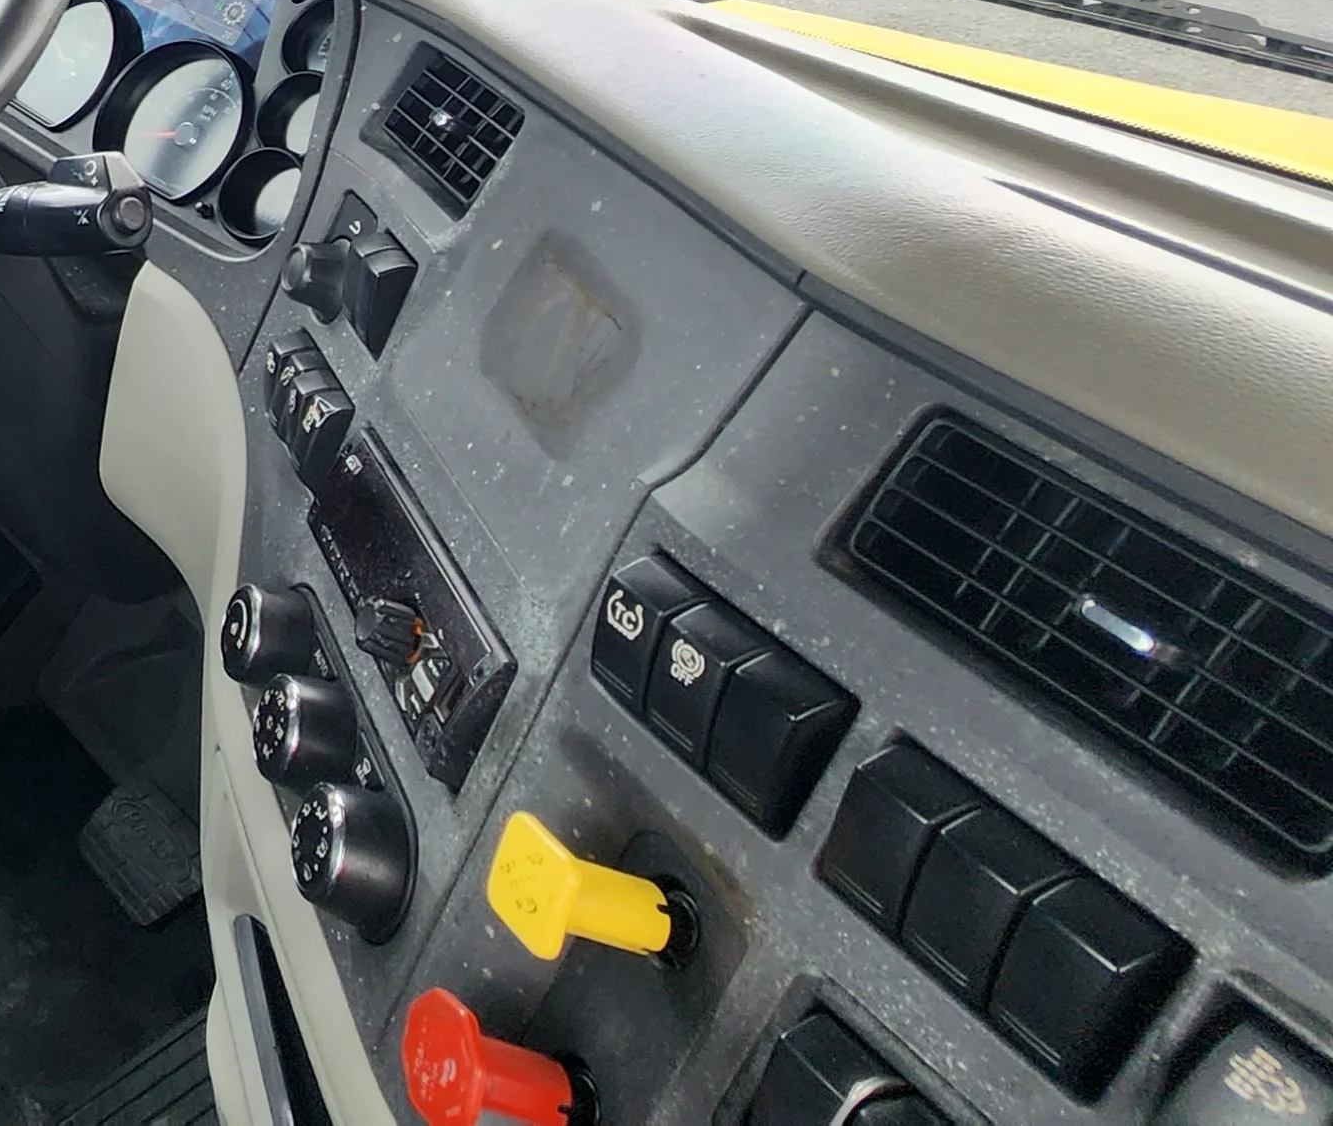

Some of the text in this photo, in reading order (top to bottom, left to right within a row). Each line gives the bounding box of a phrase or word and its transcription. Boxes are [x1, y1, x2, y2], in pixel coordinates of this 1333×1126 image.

[615, 601, 638, 631] TC
[314, 648, 329, 677] AUTO
[670, 663, 695, 686] OFF
